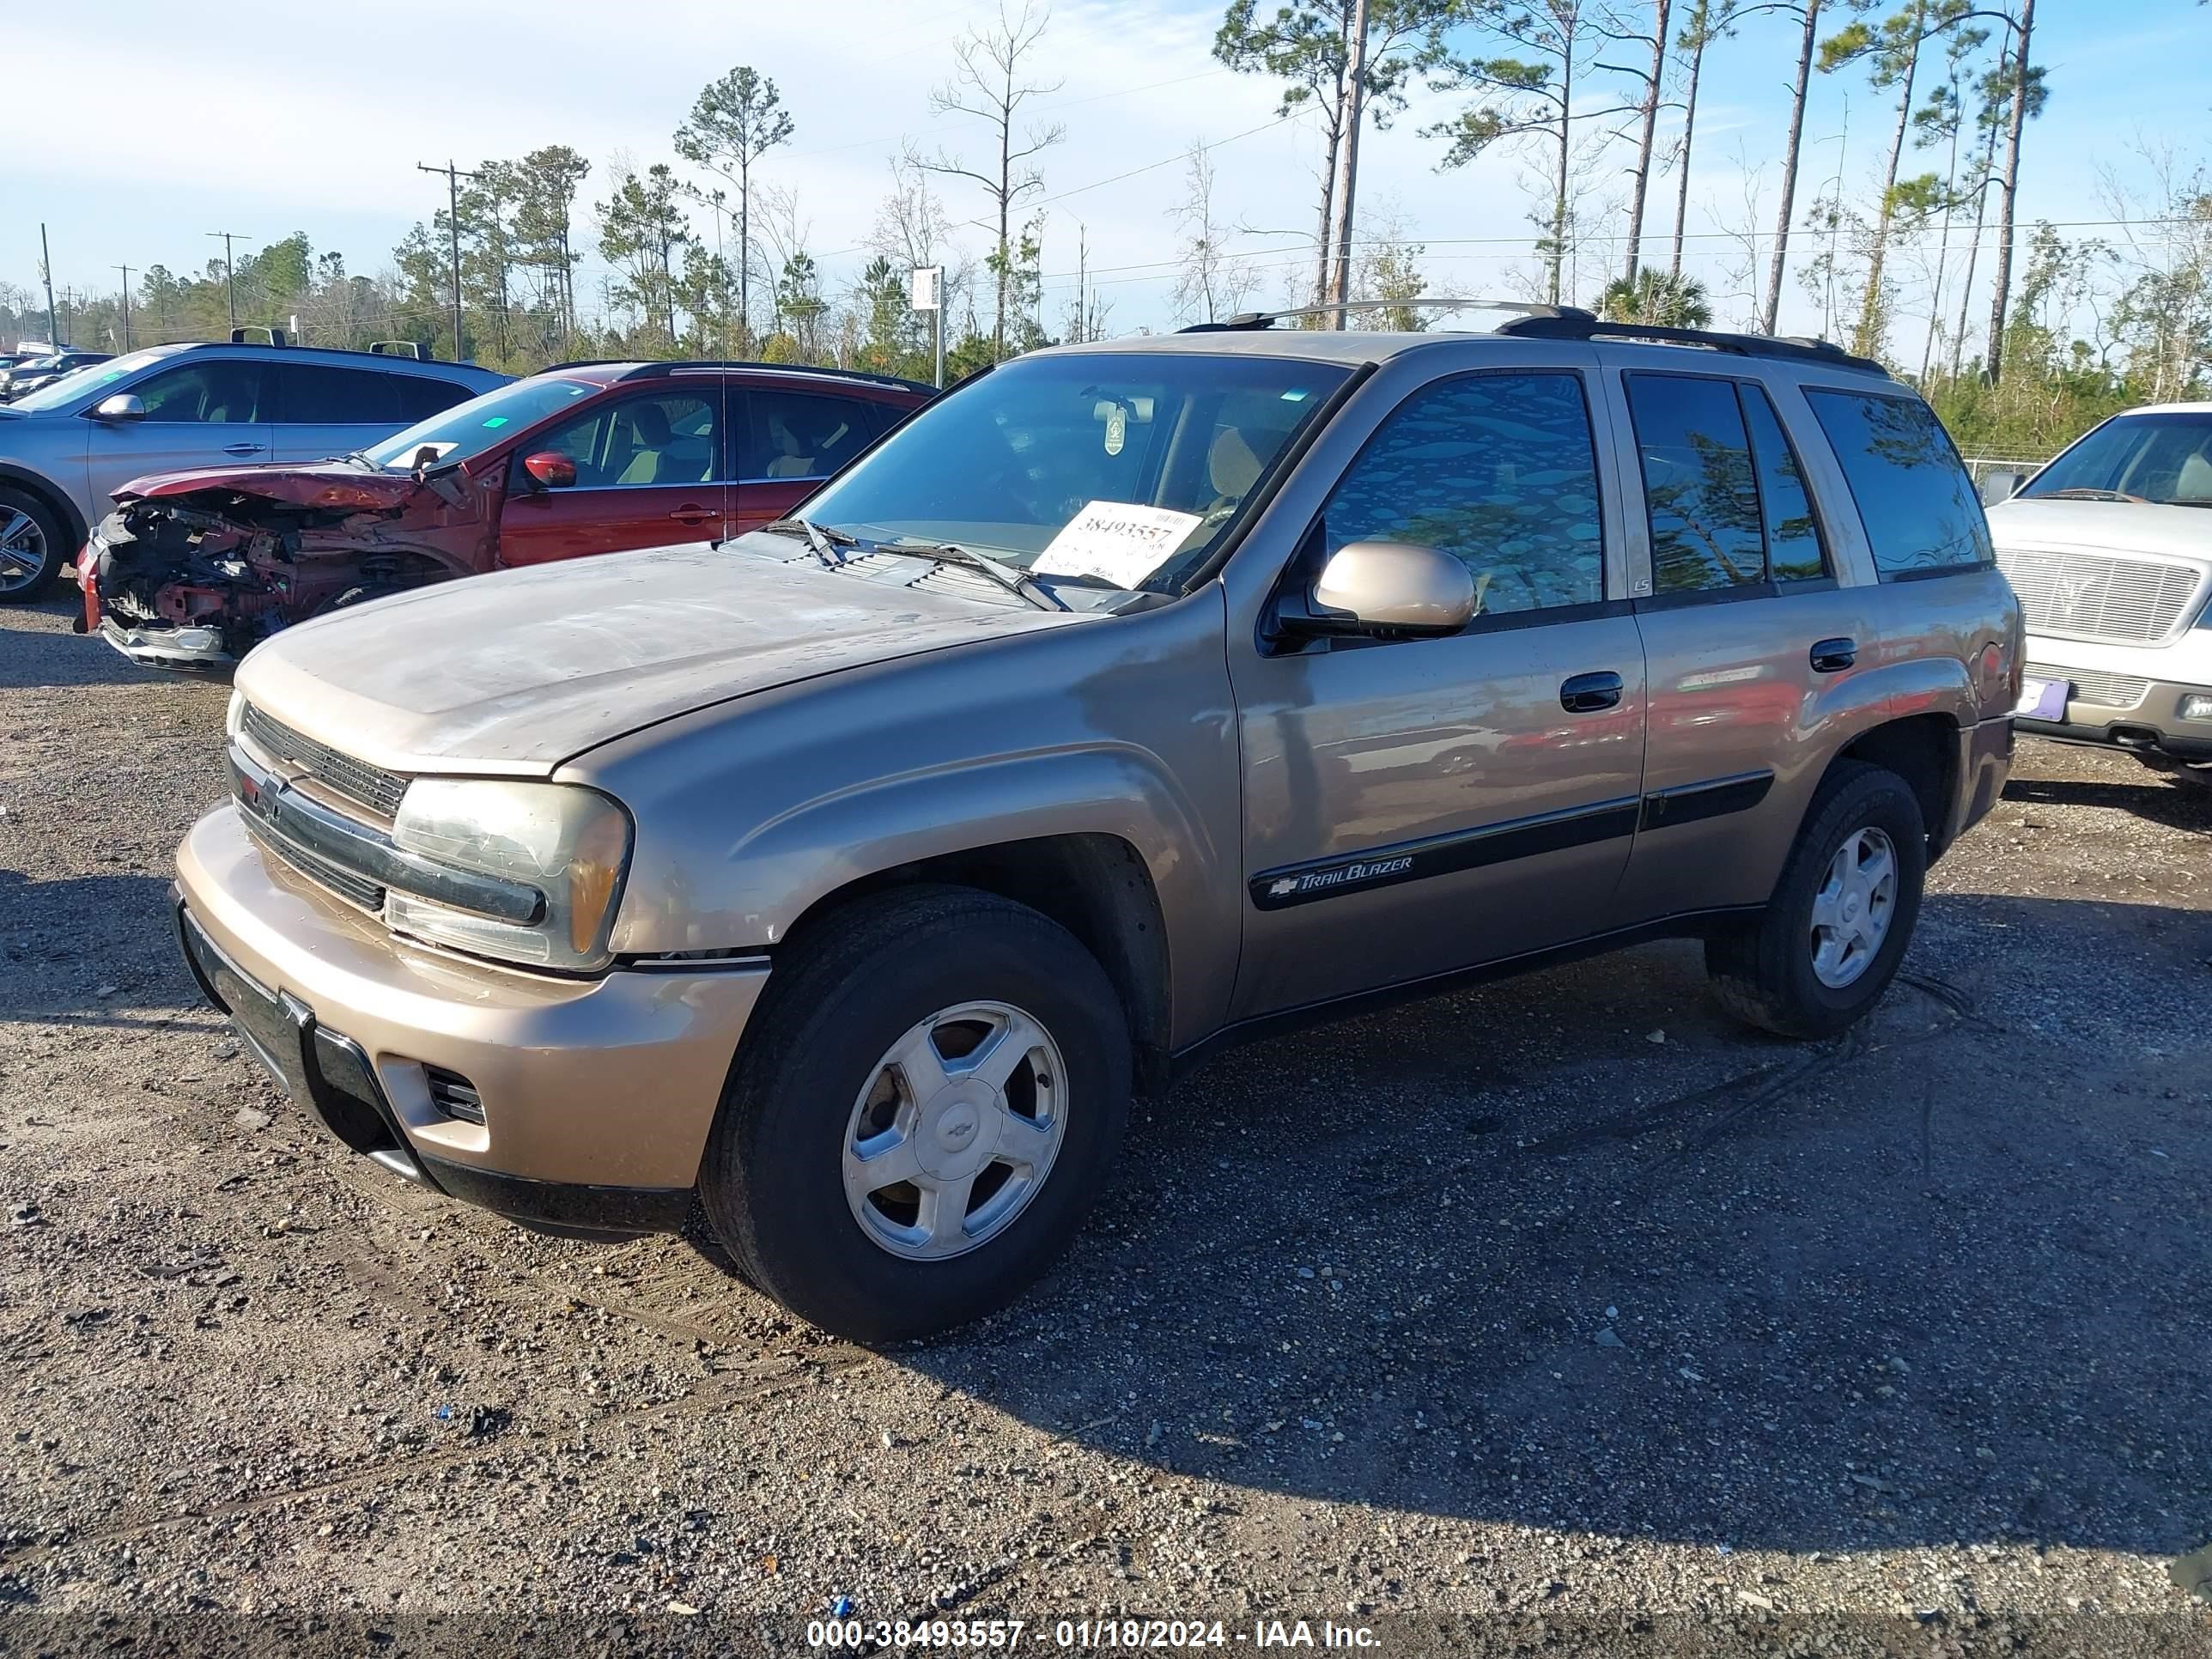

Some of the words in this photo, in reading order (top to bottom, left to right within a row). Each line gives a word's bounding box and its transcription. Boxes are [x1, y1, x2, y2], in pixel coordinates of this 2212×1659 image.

[1079, 517, 1174, 542] 38493557
[1634, 579, 1650, 592] LS
[1300, 857, 1413, 890] TRAILBLAZER
